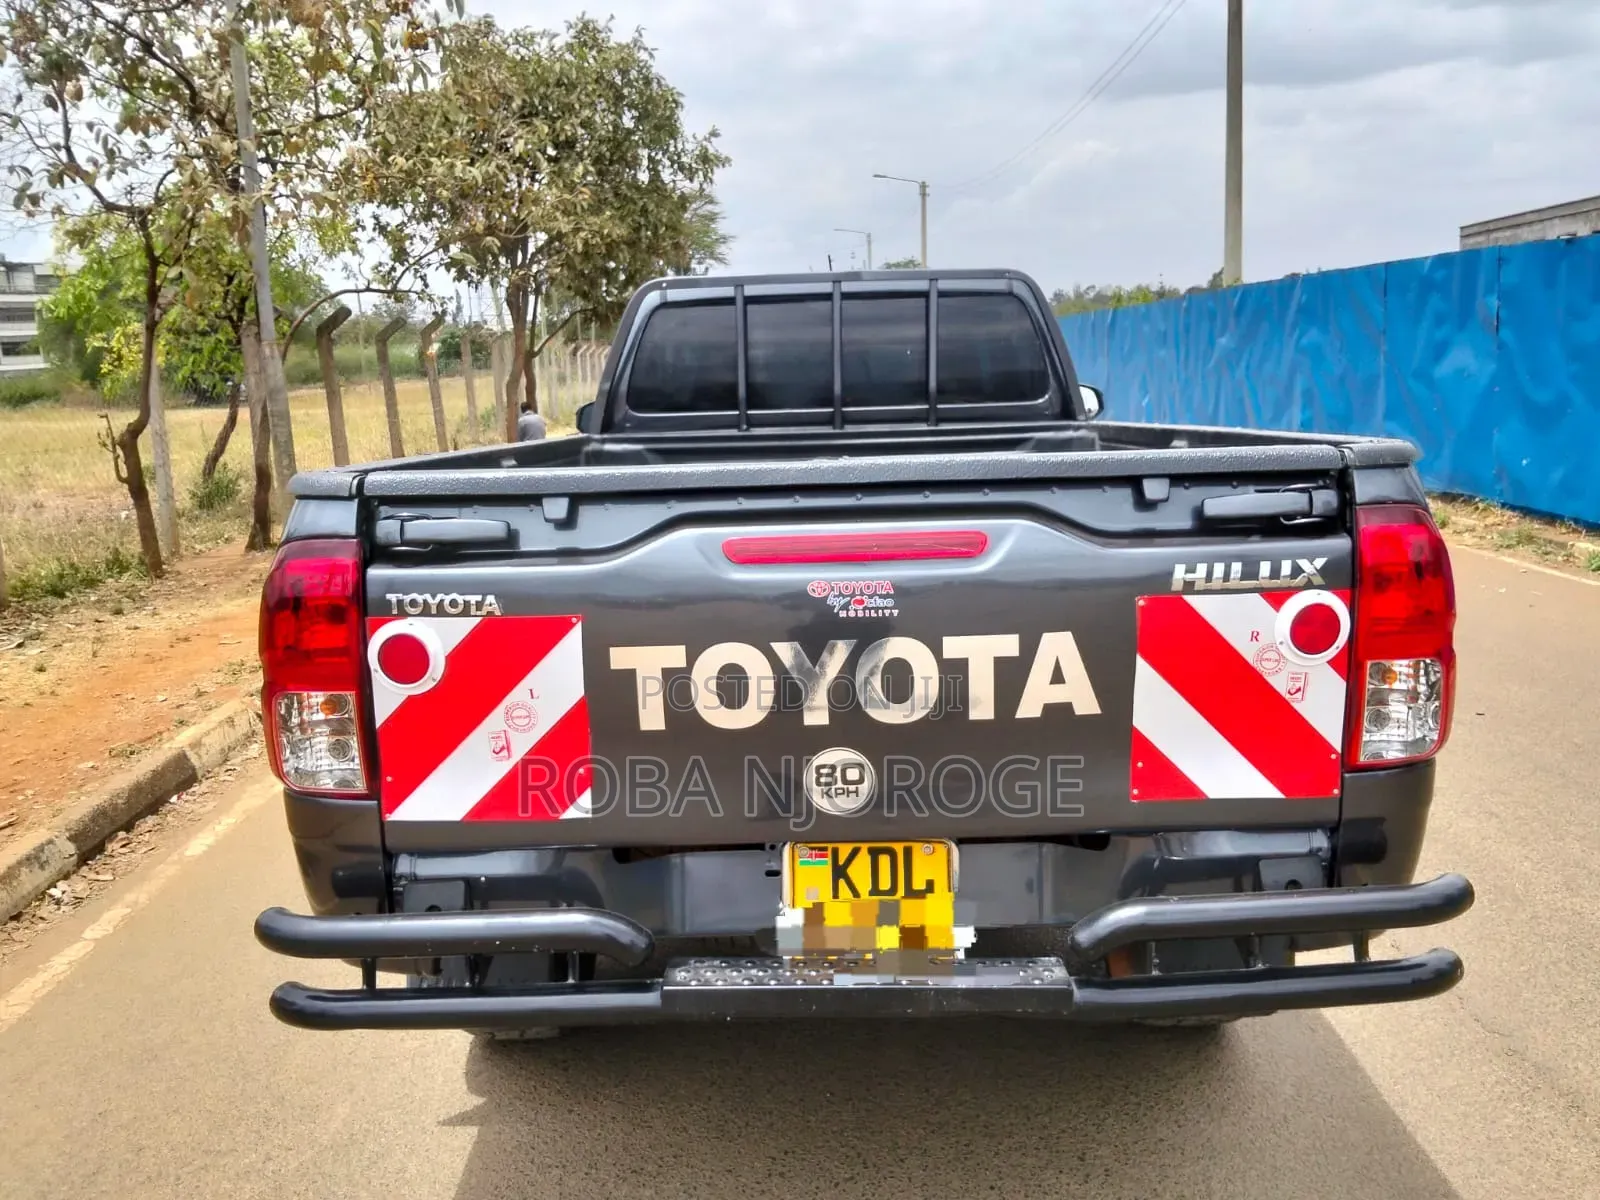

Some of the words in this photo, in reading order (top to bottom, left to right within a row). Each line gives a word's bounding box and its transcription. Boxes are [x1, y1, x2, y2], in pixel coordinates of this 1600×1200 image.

[1171, 557, 1328, 592] HILUX
[831, 580, 894, 595] TOYOTA
[385, 592, 502, 616] TOYOTA
[839, 609, 899, 617] MOBILITY
[1249, 630, 1260, 642] R
[609, 631, 1102, 732] TOYOTA
[528, 688, 540, 700] L
[814, 762, 866, 788] 80
[820, 787, 861, 799] KPH
[831, 846, 935, 899] KDL
